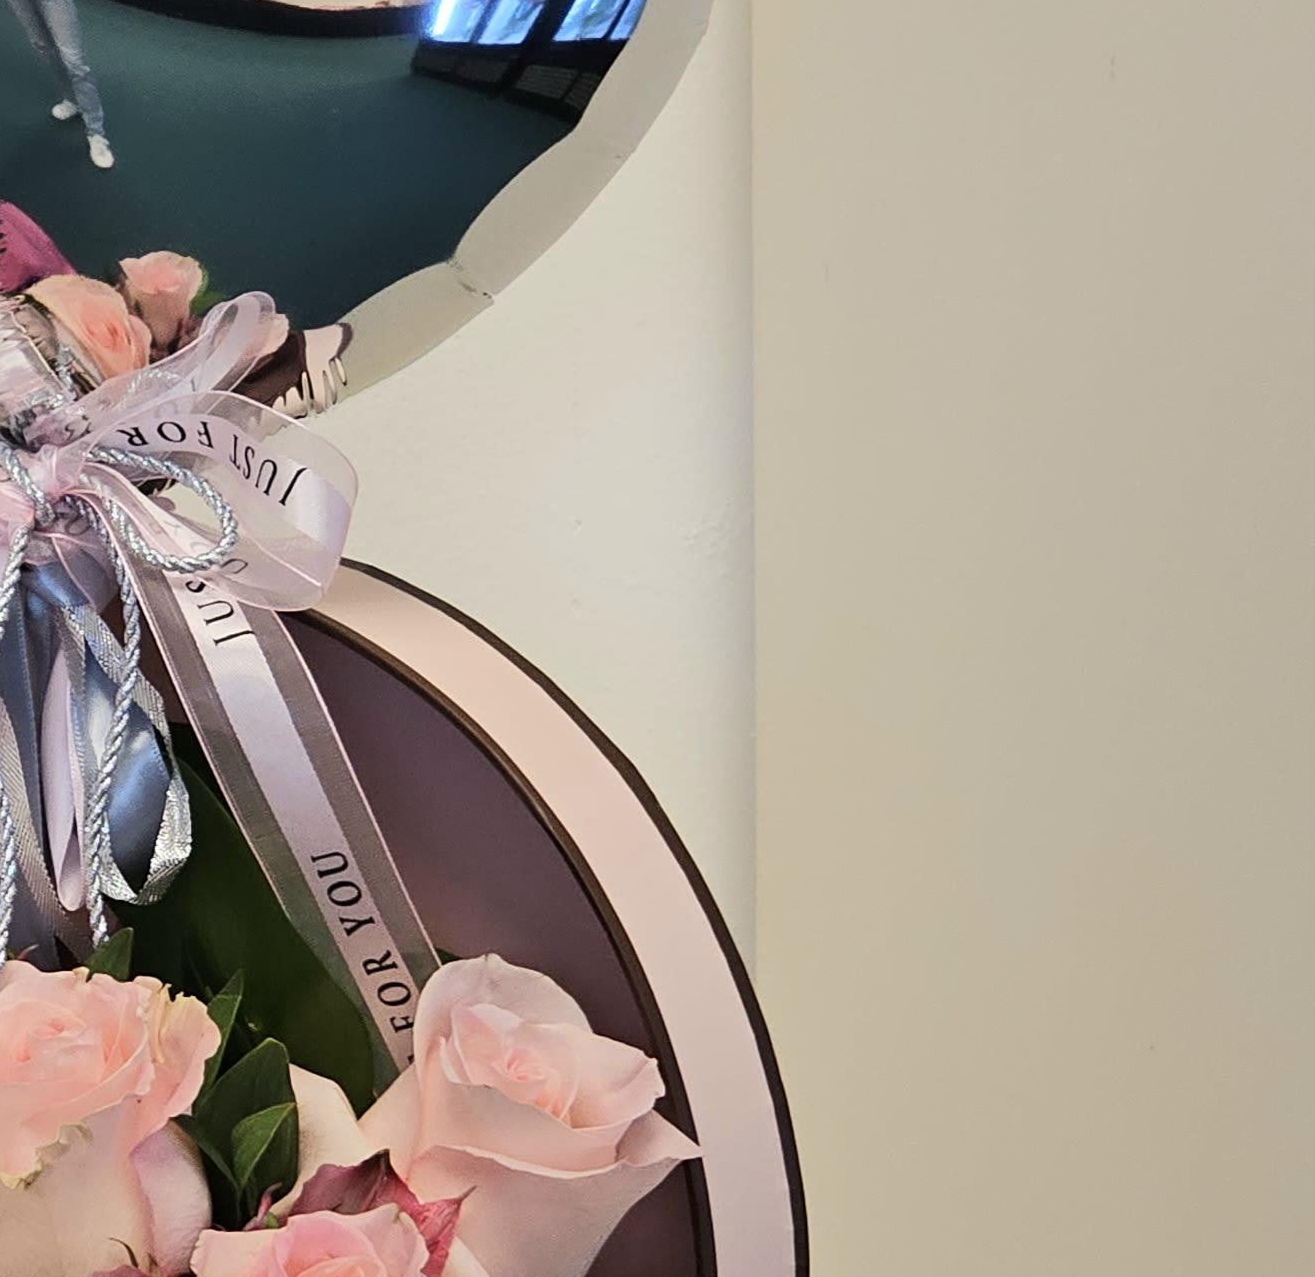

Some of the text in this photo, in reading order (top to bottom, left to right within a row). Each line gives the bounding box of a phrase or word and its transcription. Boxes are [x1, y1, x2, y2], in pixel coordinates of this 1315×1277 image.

[116, 420, 214, 449] FOR
[230, 433, 308, 507] JUST
[310, 851, 415, 1034] FOR YOU
